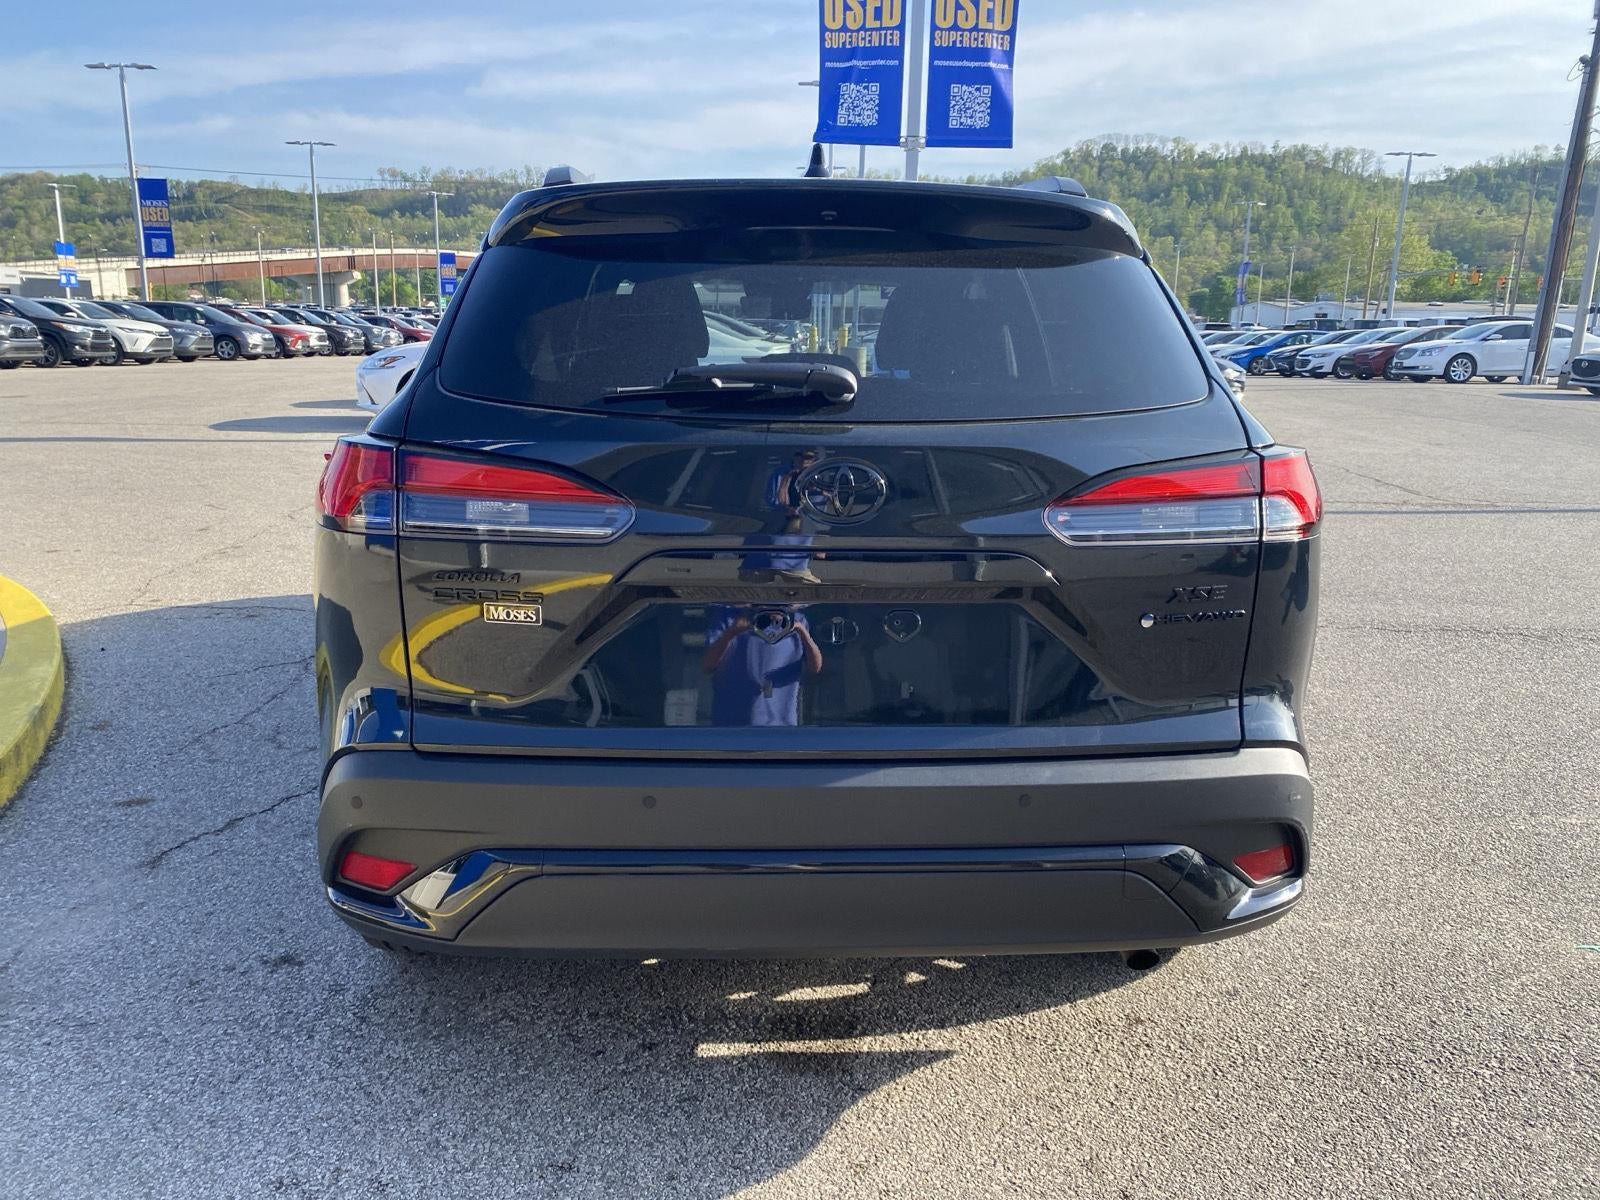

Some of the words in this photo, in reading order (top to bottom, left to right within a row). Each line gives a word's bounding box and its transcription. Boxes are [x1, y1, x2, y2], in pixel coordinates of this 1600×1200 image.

[824, 0, 902, 30] USED
[934, 0, 1013, 32] USED
[825, 30, 900, 49] SUPERCENTER
[934, 30, 1010, 50] SUPERCENTER
[141, 207, 170, 222] USED
[432, 570, 521, 584] COROLLA
[432, 587, 544, 604] CROSS
[1166, 584, 1228, 604] XSE
